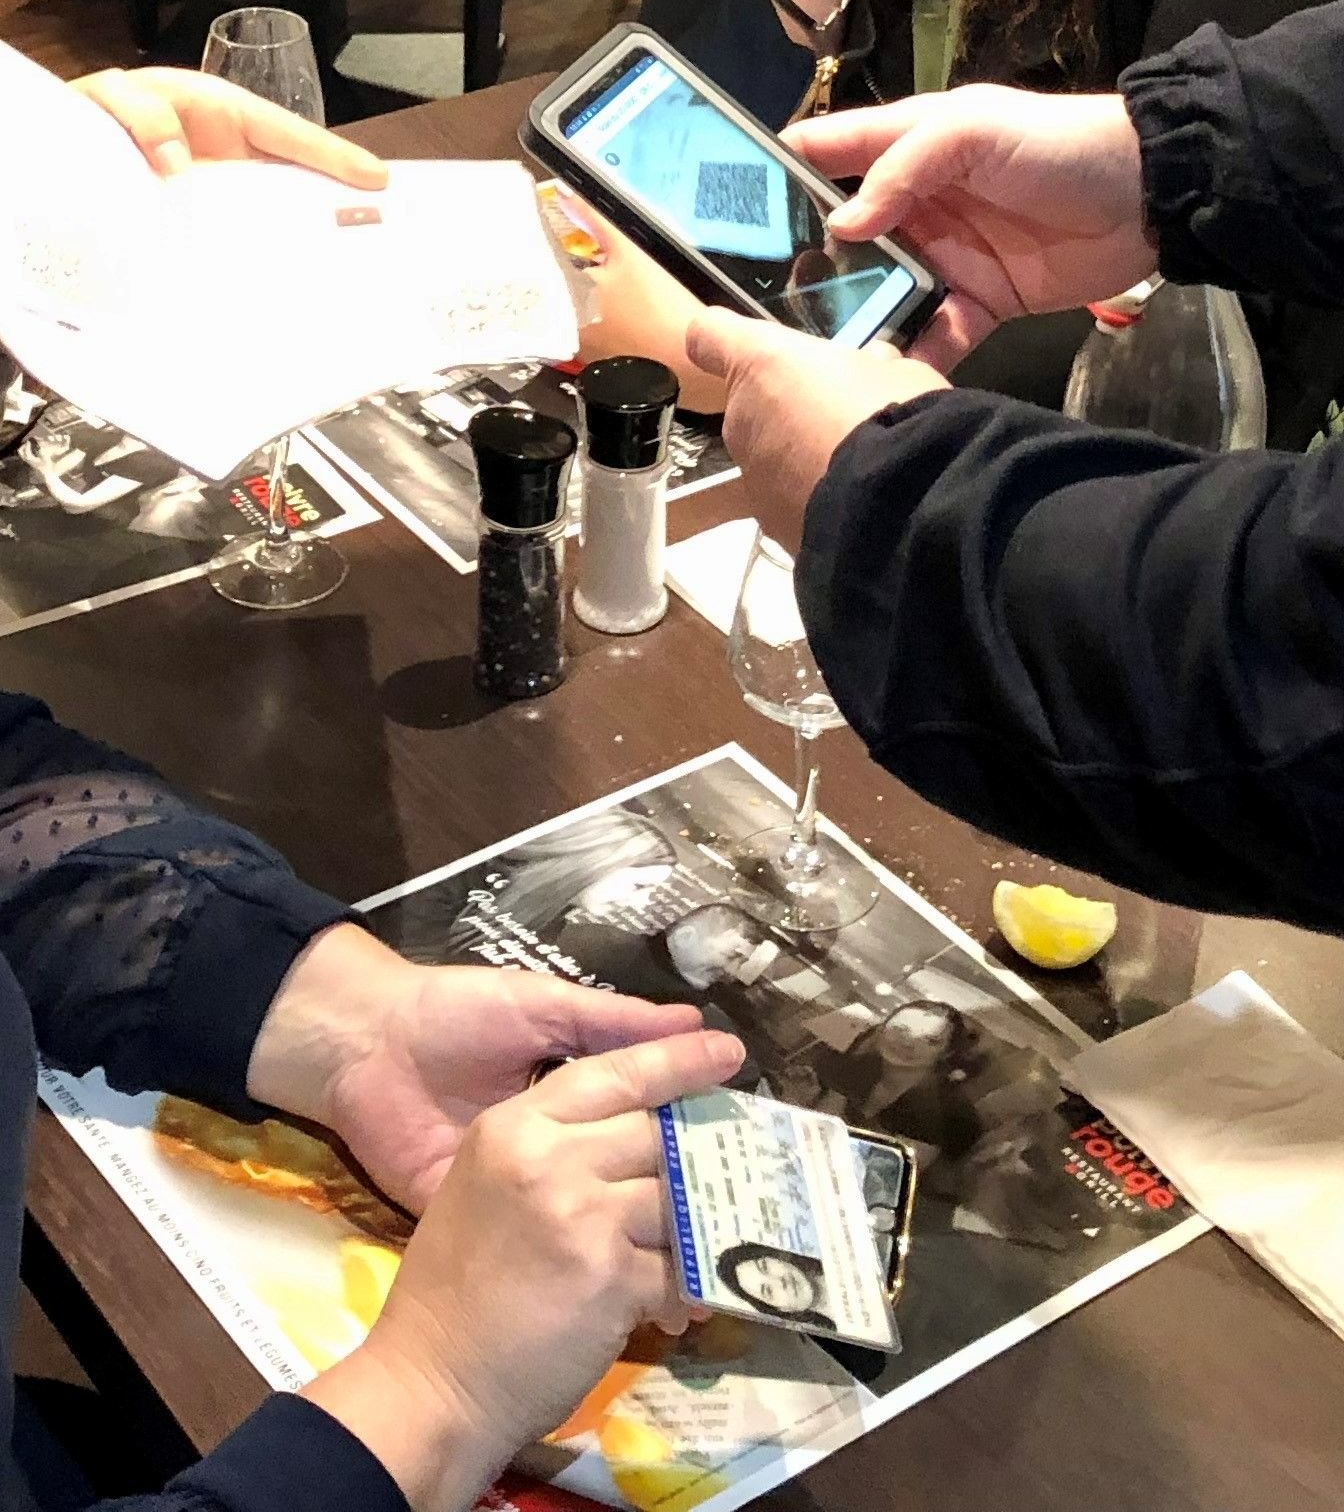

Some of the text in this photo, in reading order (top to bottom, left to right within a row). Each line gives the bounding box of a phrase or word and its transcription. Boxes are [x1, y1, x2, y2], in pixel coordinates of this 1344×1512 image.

[468, 891, 500, 913] Pas
[52, 1083, 84, 1118] VOTRE
[108, 1152, 147, 1196] MANGEZ
[156, 1212, 190, 1250] MOINS
[1061, 1147, 1143, 1212] RESTAURANT
[1070, 1126, 1174, 1210] rouge
